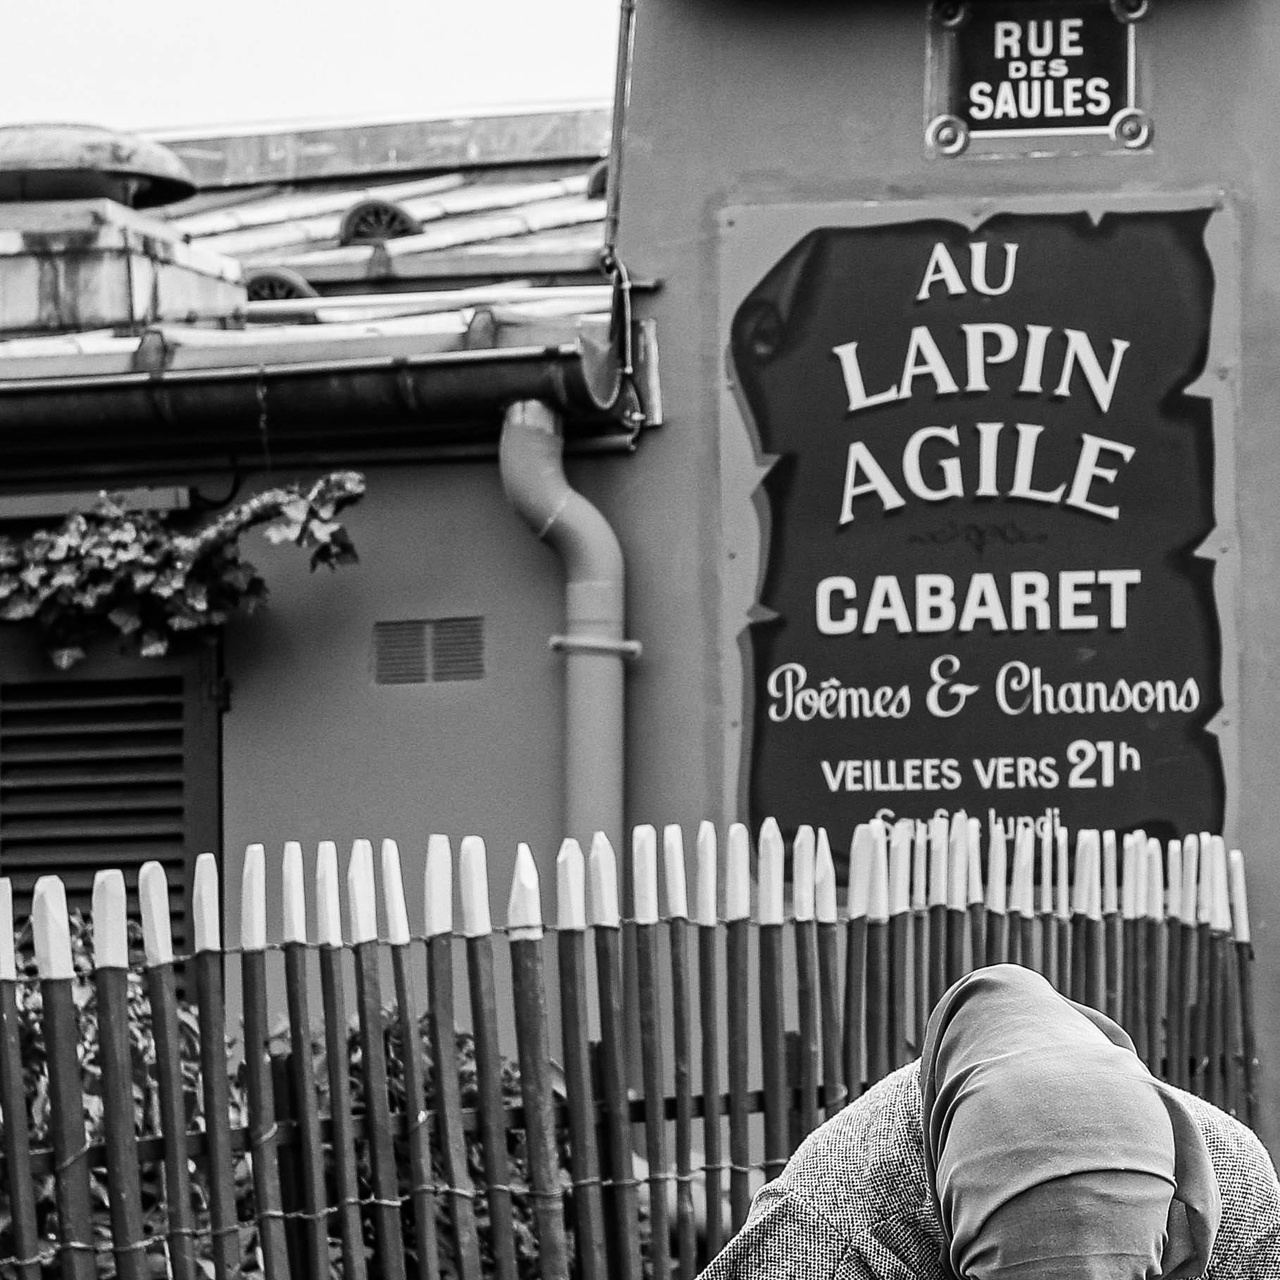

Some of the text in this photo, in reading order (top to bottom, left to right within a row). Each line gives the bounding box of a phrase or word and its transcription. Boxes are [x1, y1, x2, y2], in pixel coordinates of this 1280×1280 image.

[994, 18, 1084, 59] RUE
[1008, 58, 1069, 79] DES
[968, 77, 1111, 120] SAULES
[916, 241, 1019, 300] AU
[832, 322, 1130, 413] LAPIN
[838, 422, 1136, 525] AGILE
[815, 569, 1142, 635] CABARET
[926, 654, 979, 718] &
[995, 660, 1200, 716] Chansons
[821, 739, 1141, 792] VEILLEES VERS 21h
